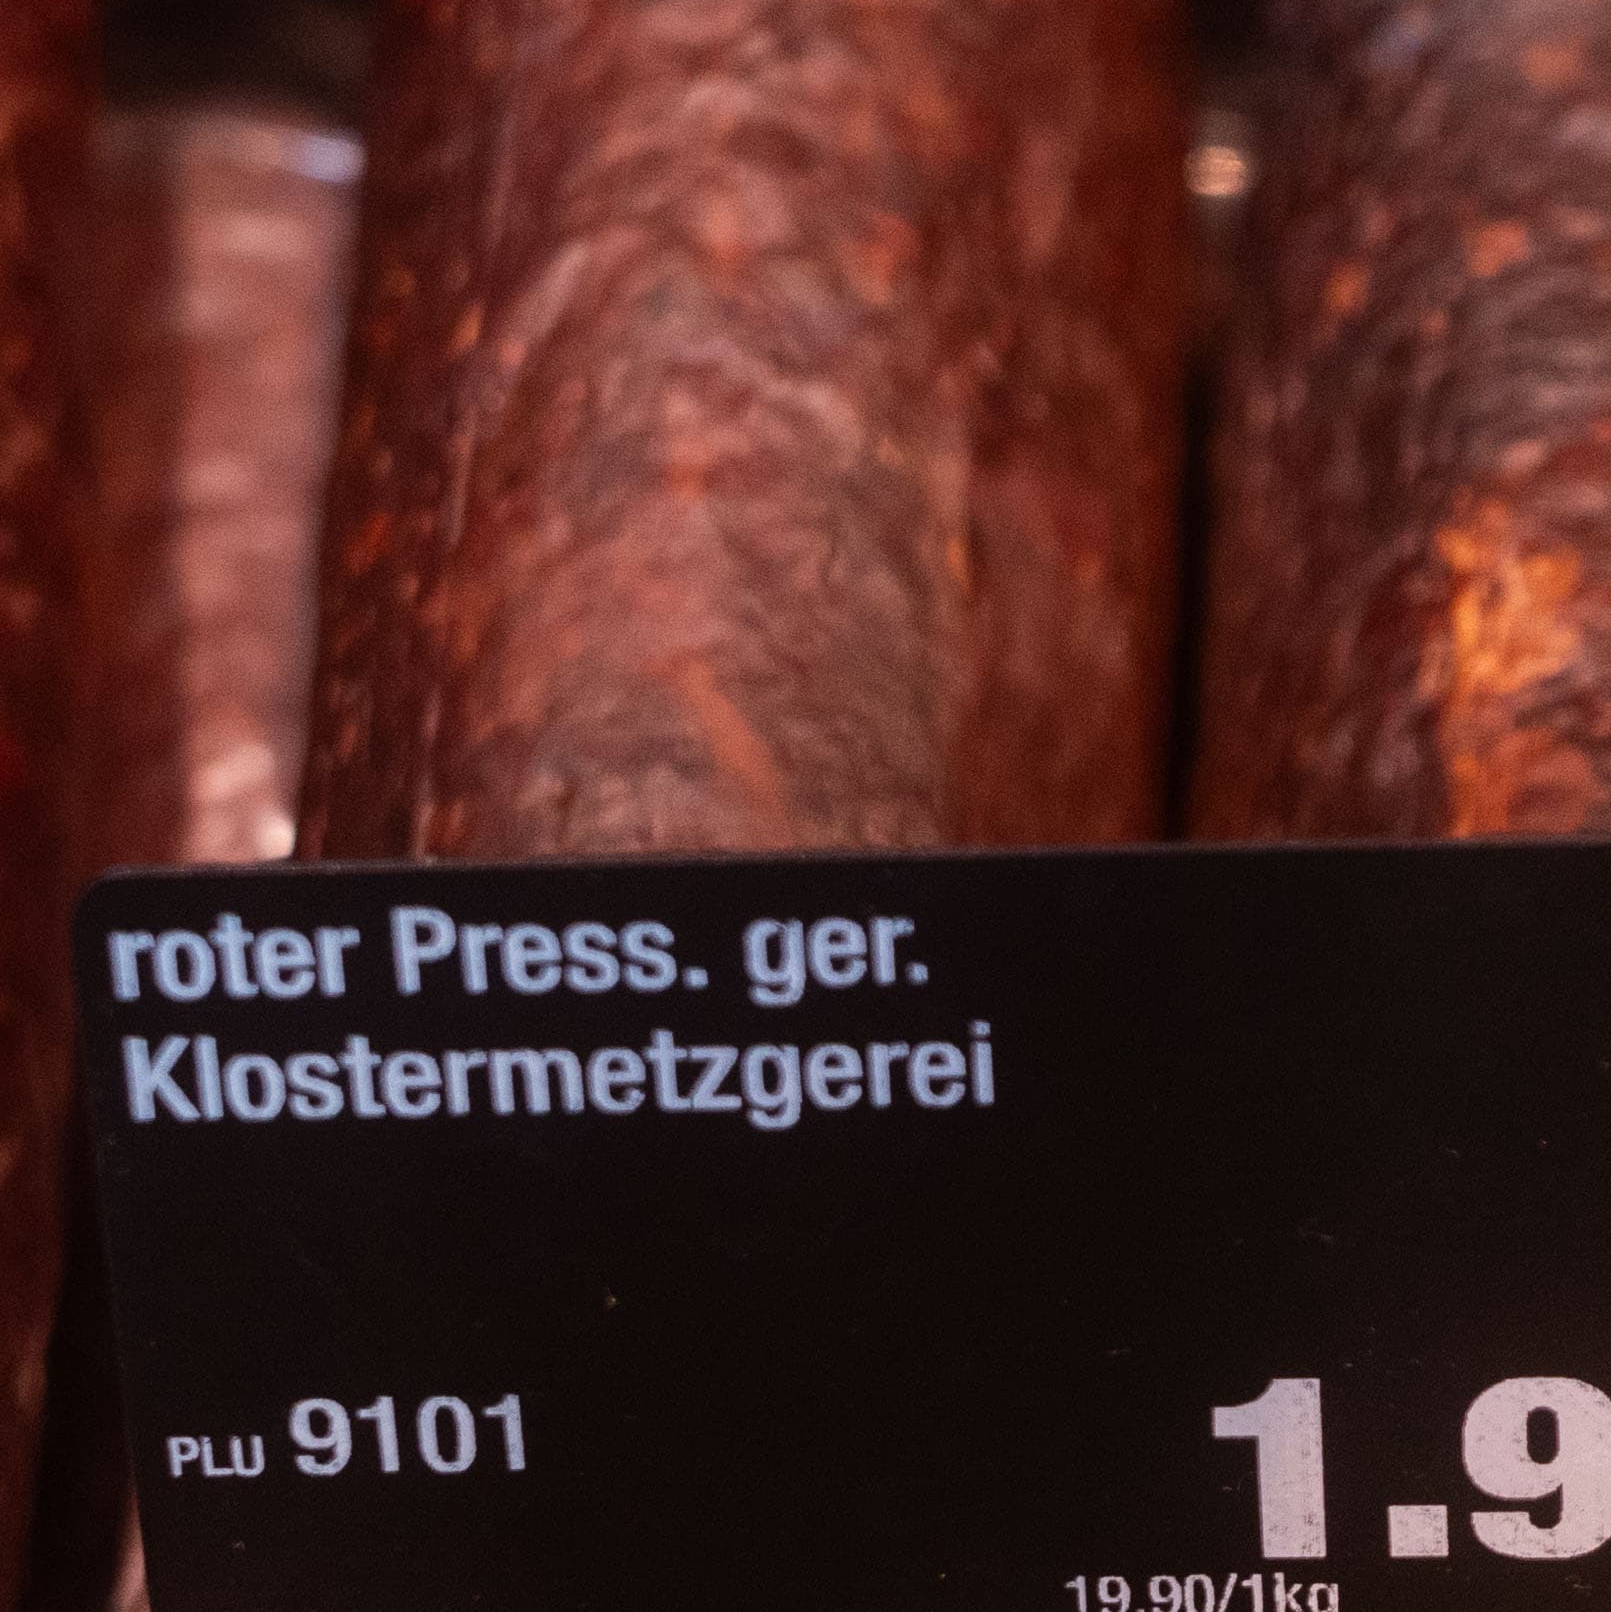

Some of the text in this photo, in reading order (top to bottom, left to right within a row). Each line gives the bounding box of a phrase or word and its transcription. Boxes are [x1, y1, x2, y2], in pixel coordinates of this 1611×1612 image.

[108, 906, 929, 1007] roter Press. ger.
[122, 1020, 995, 1131] Klostermetzgerei
[166, 1394, 527, 1478] PLU 9101
